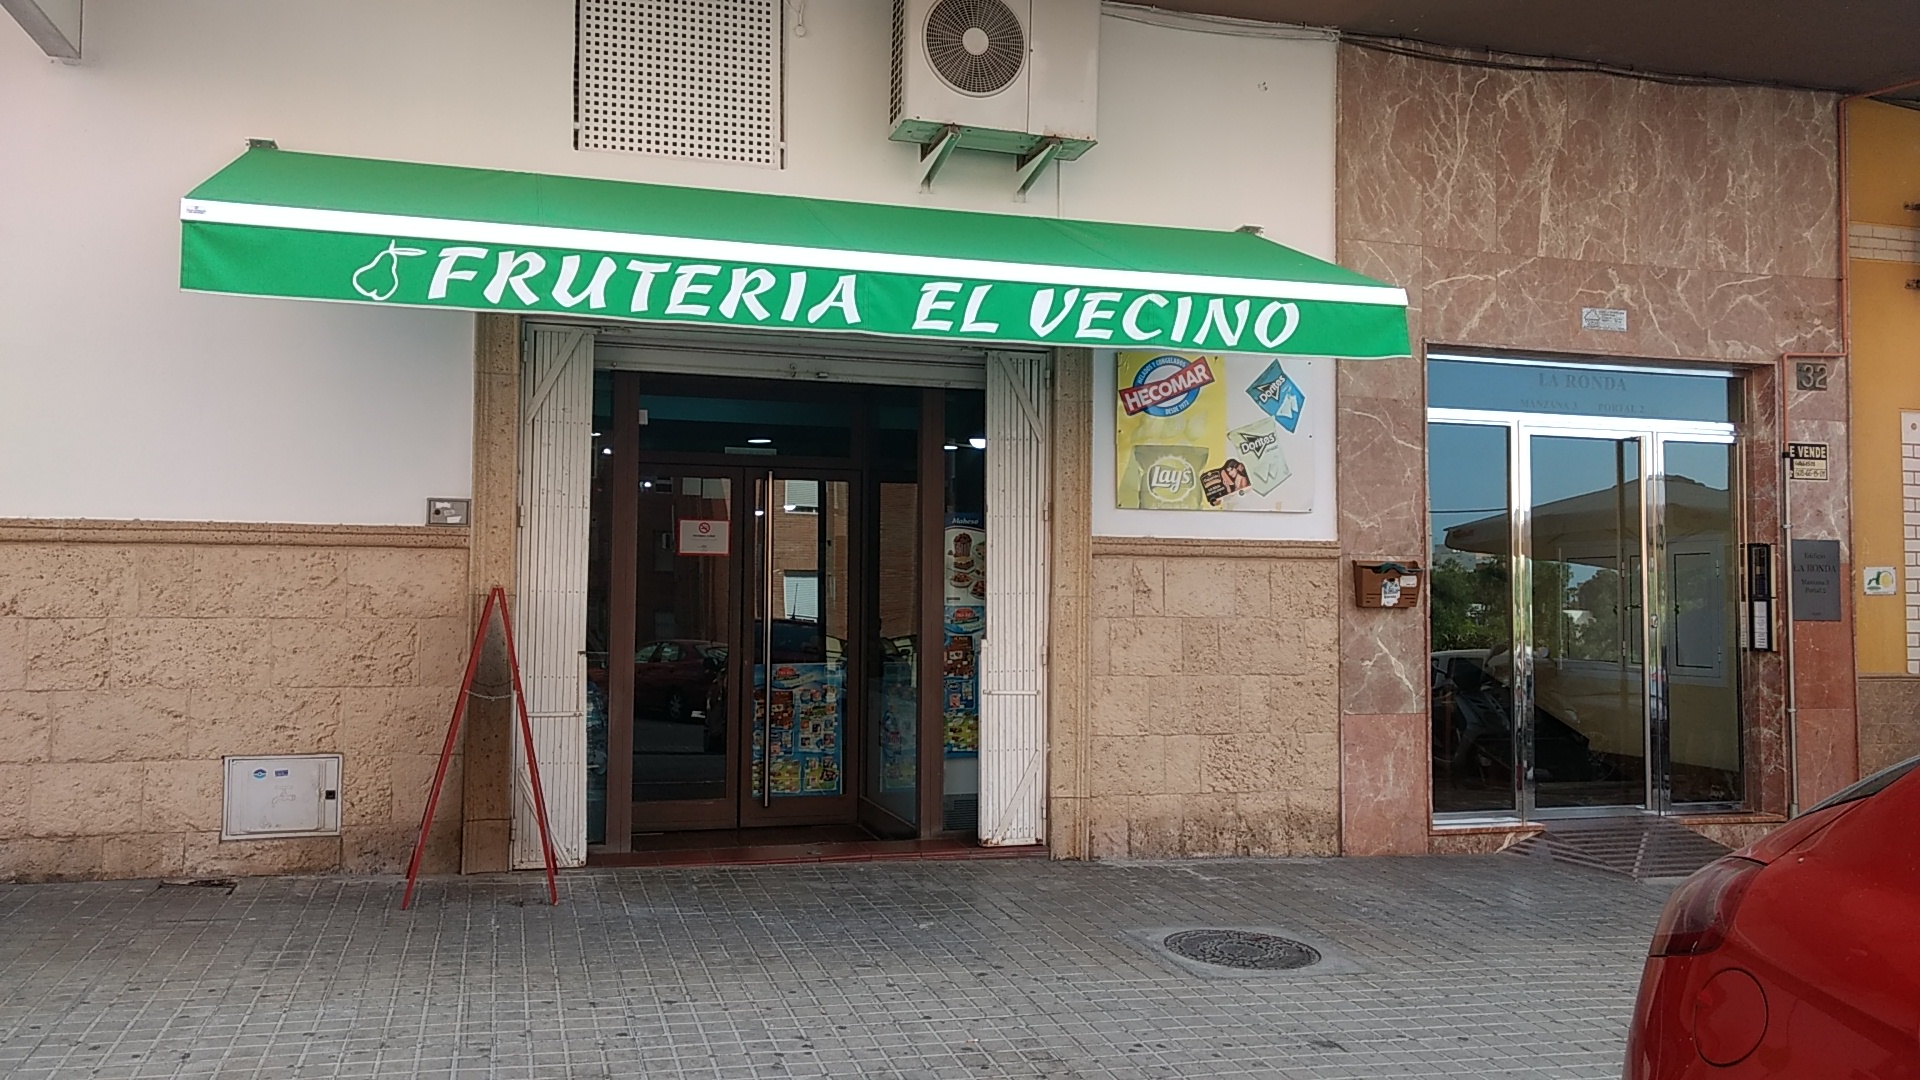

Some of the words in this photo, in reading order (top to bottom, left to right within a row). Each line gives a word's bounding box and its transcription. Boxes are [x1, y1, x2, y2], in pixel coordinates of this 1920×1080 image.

[427, 246, 861, 325] FRUTERIA
[912, 281, 999, 333] EL
[1029, 287, 1300, 348] VECINO
[1124, 363, 1210, 411] HECOMAR
[1538, 372, 1558, 388] LA
[1565, 374, 1627, 391] RONDA
[1801, 364, 1828, 389] 32
[1259, 375, 1286, 403] Doritos
[1520, 399, 1569, 410] MANZANA
[1598, 403, 1636, 413] PORTAL
[1639, 405, 1645, 413] 2
[1241, 433, 1275, 455] Doritos
[1797, 446, 1827, 459] VENDE
[1806, 564, 1837, 573] RONDA
